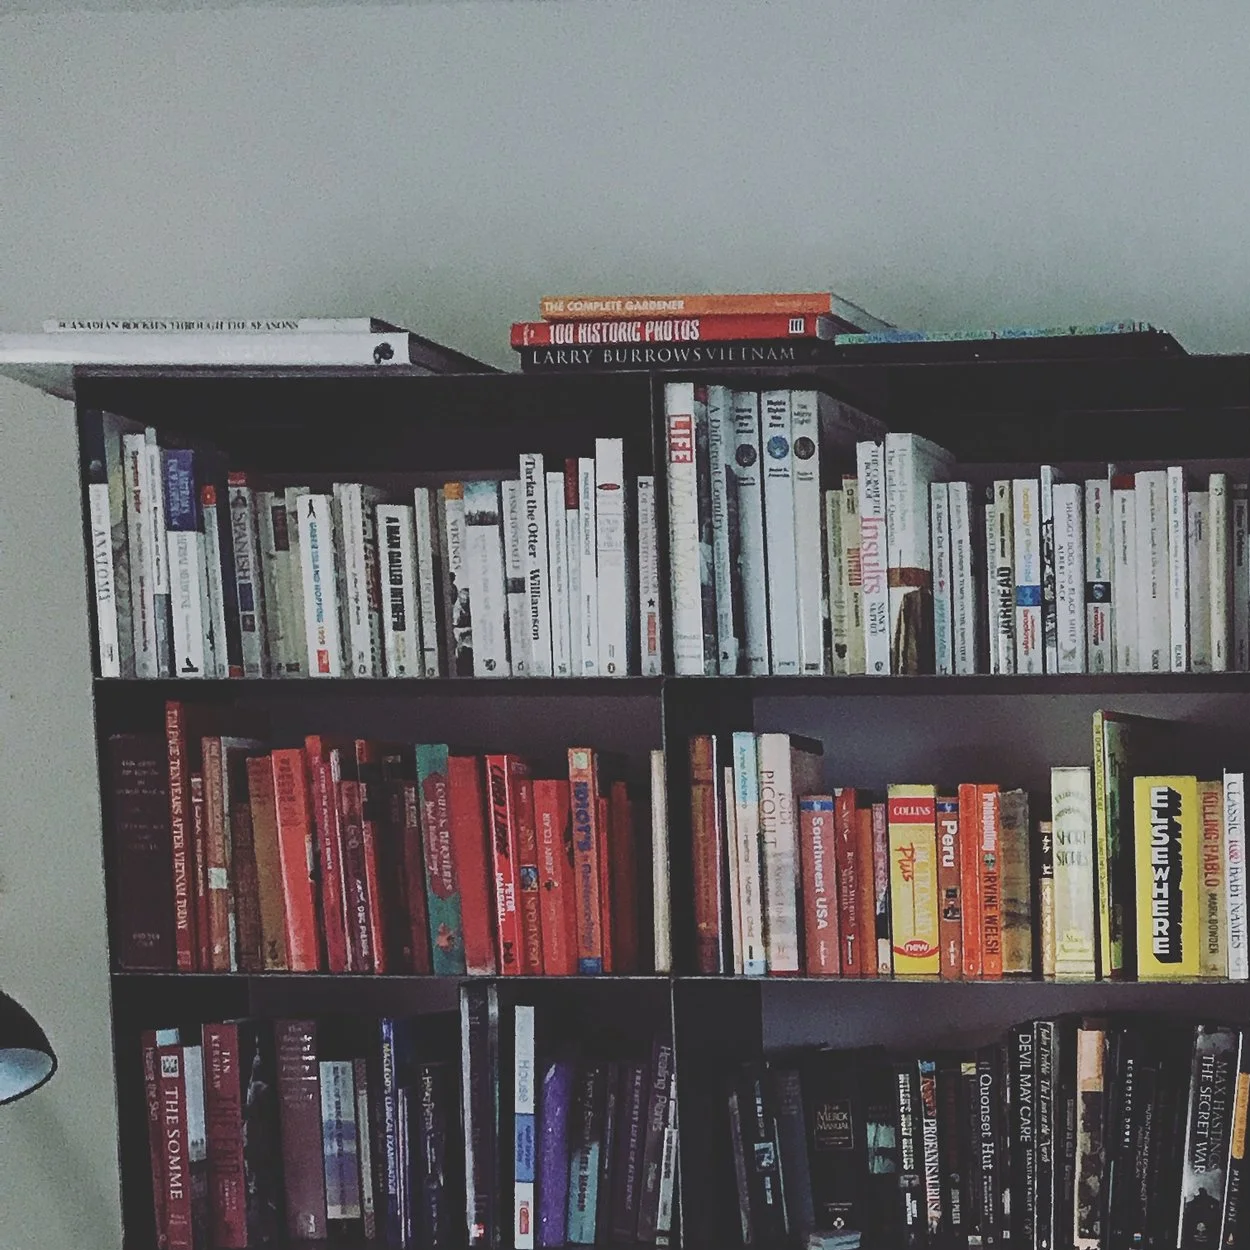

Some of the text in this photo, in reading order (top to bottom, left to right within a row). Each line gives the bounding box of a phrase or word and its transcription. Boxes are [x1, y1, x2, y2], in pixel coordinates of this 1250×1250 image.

[545, 300, 684, 312] THE COMPLETE GARDENER
[550, 319, 700, 345] 100 HISTORIC PHOTOS
[533, 347, 796, 365] LARRY BURROWS VIETNAM
[671, 416, 691, 463] LIFE
[709, 404, 725, 532] A Different Country
[232, 512, 249, 581] SPANISH
[449, 519, 461, 570] VIKINGS
[525, 459, 541, 641] Tarka the Otter Williamson
[861, 515, 886, 595] Insults
[1066, 501, 1076, 615] SHAGGY DOGS BLACK
[997, 566, 1014, 639] JARHEAD
[167, 708, 188, 931] TIM TEN YEARS AFTER VIETNAM TODAY
[575, 781, 592, 852] IDIOT'S
[760, 770, 777, 848] PICOULT
[893, 805, 931, 816] COLLINS
[941, 820, 958, 868] Peru
[811, 815, 828, 930] Southwest USA
[894, 842, 916, 883] Plus
[1151, 786, 1178, 958] ELSEWHERE
[1202, 791, 1221, 918] KILLING PABLO MARK
[1226, 781, 1242, 949] CLASSIC BABY NAMES
[495, 872, 506, 923] MARSHALL
[505, 882, 516, 912] PETER
[983, 871, 999, 956] IRVINE WELSH
[904, 943, 929, 952] new
[147, 1084, 157, 1098] the
[210, 1034, 221, 1090] KERSHAW
[221, 1050, 231, 1074] IAN
[651, 1045, 671, 1133] Healing Plants
[1018, 1034, 1032, 1142] DEVIL MAY CARE
[164, 1086, 183, 1200] THE SOMME
[385, 1096, 397, 1195] CLINICAL EXAMINATION
[816, 1111, 848, 1121] MERCK
[816, 1121, 849, 1130] MANUAL
[898, 1073, 915, 1171] HITLER'S RELICS
[978, 1073, 995, 1171] Quonset Hut
[1193, 1054, 1216, 1175] THE SECRET WAR
[1210, 1061, 1229, 1170] MAX HASTINGS
[923, 1119, 942, 1213] PROFANISAURUS
